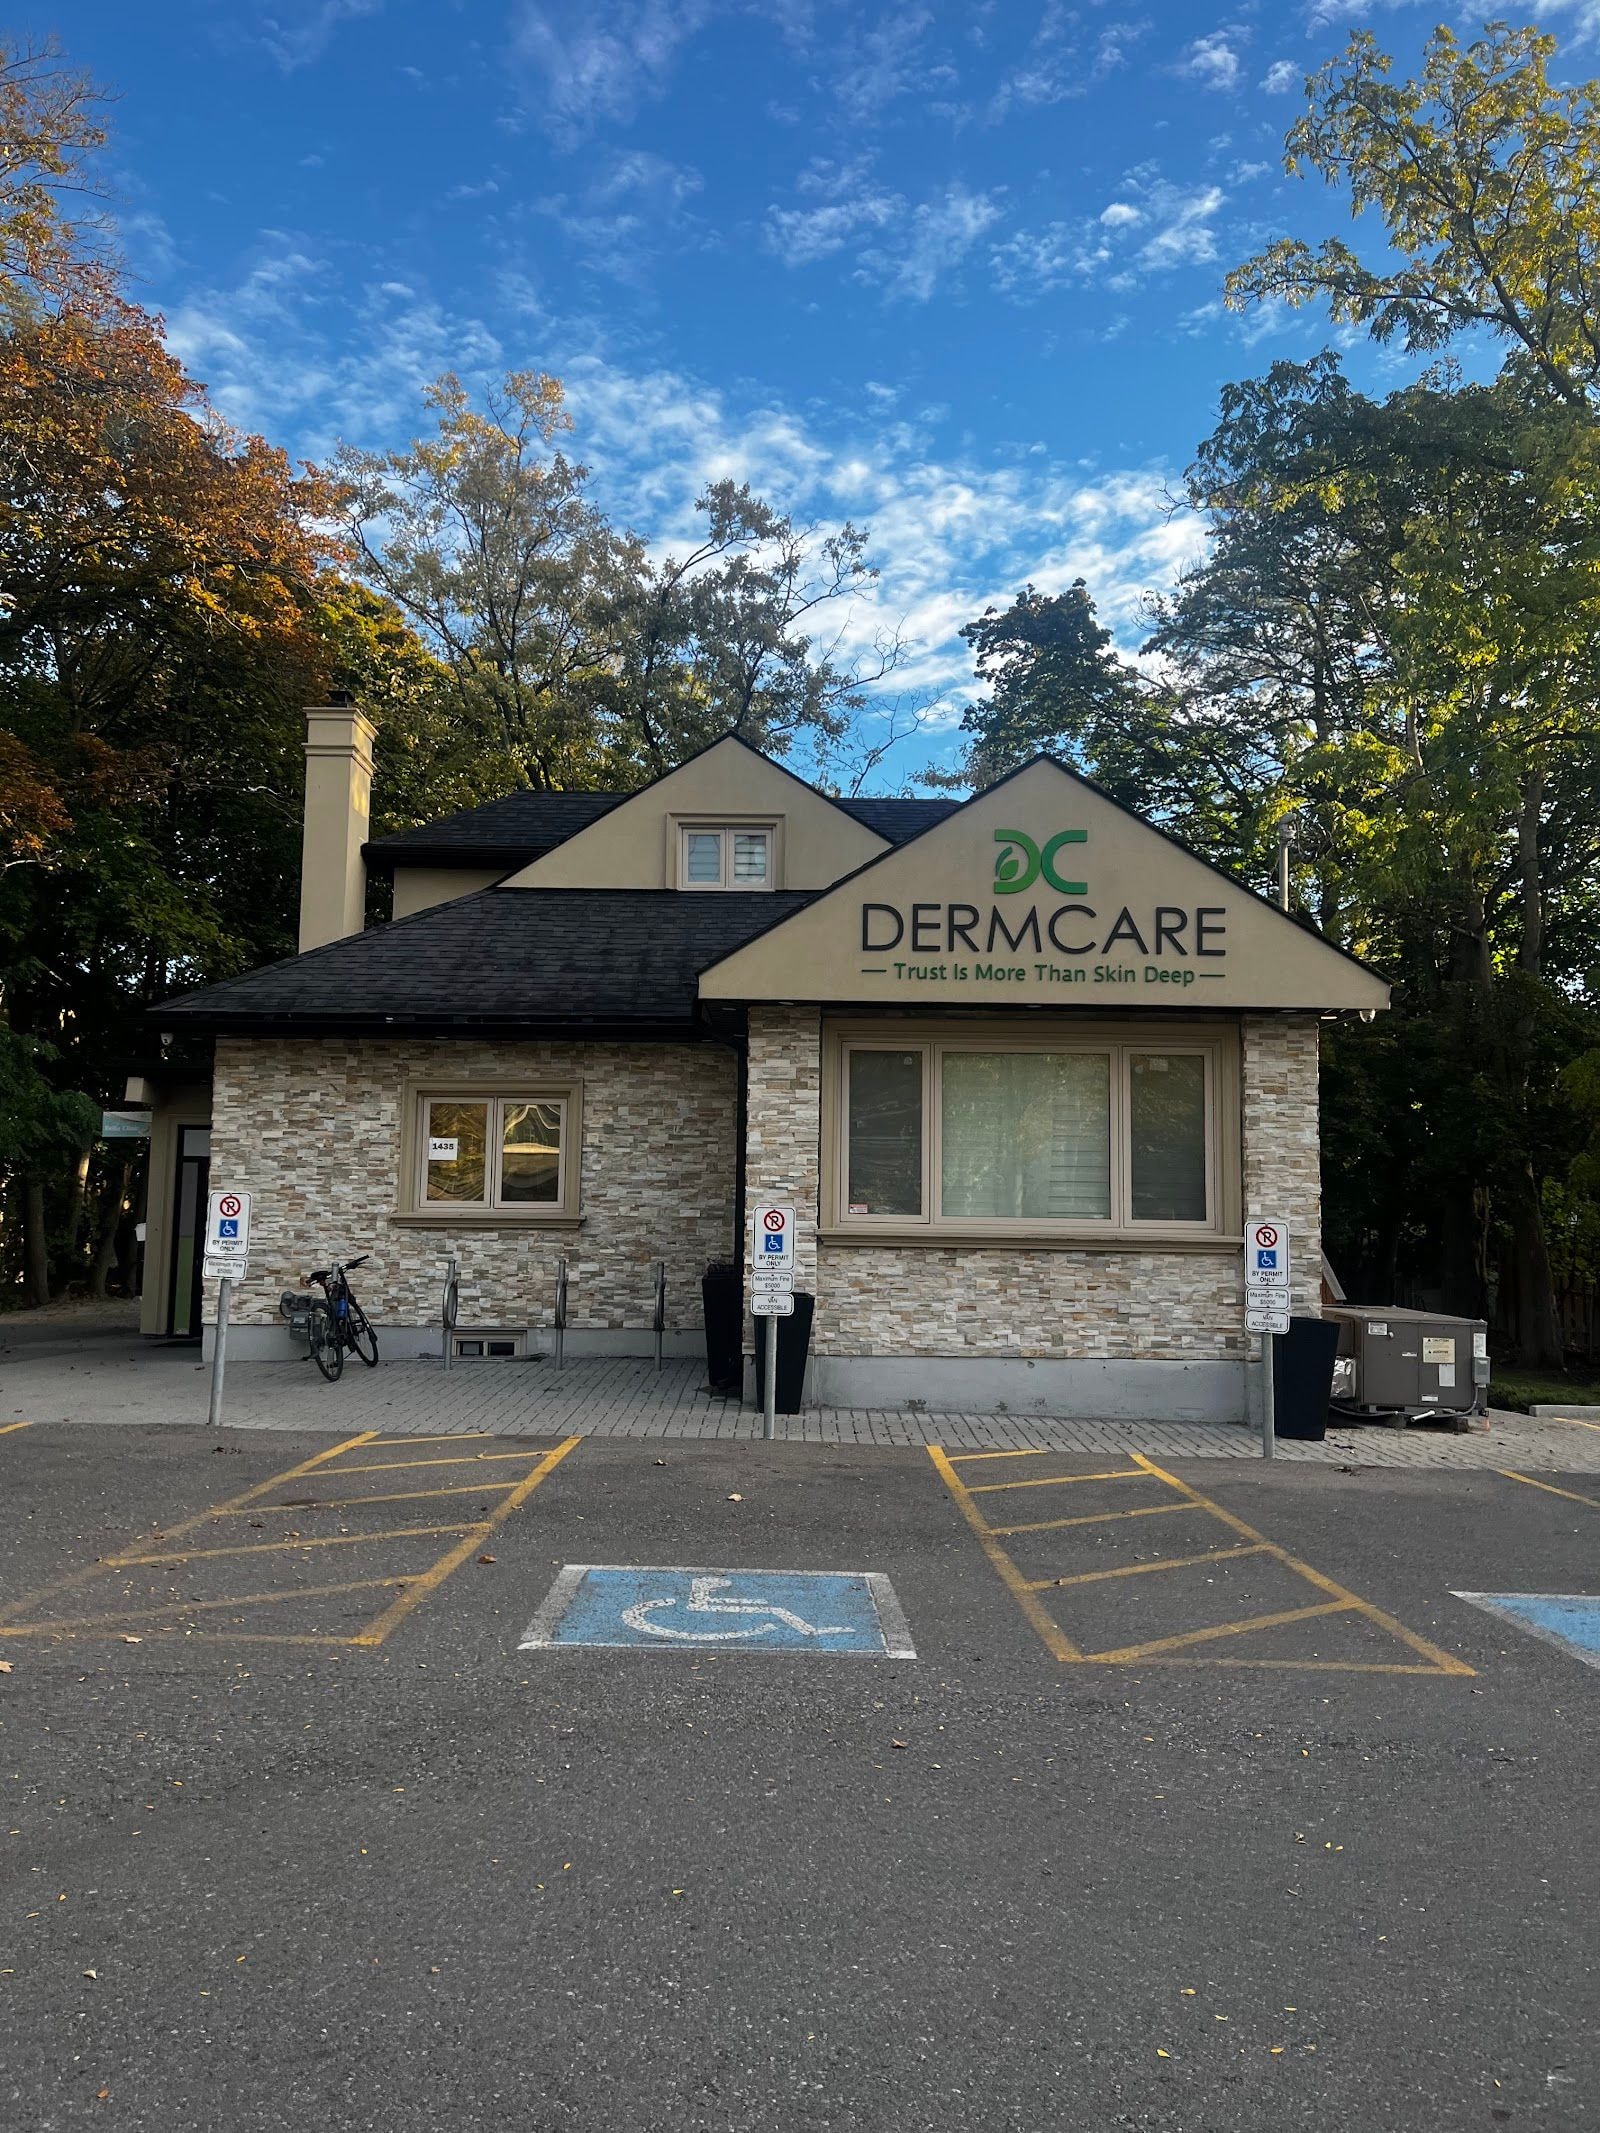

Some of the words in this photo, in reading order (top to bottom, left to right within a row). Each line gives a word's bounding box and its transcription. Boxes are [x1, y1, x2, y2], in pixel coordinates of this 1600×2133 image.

[861, 903, 1226, 956] DERMCARE
[893, 963, 947, 980] Trust
[954, 963, 968, 981] Is
[975, 964, 1026, 981] More
[1034, 964, 1086, 982] Than
[1093, 966, 1136, 983] Skin
[1144, 966, 1195, 987] Deep
